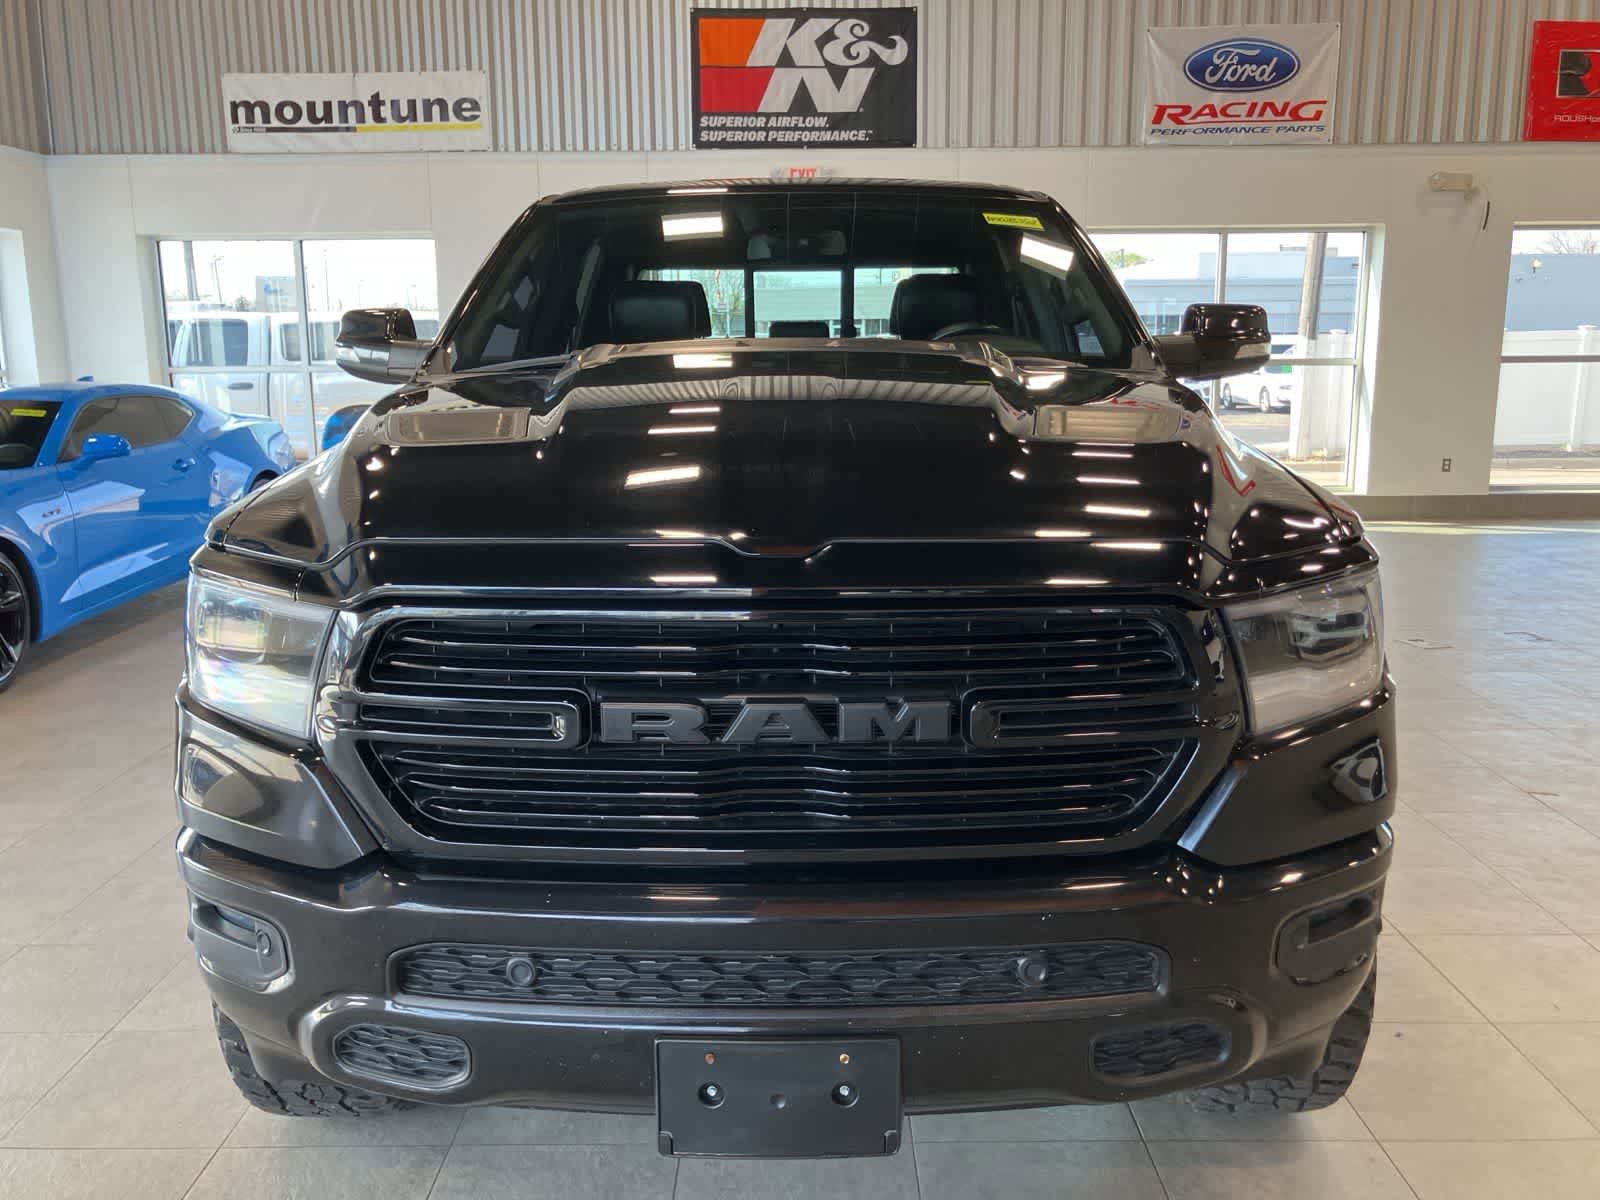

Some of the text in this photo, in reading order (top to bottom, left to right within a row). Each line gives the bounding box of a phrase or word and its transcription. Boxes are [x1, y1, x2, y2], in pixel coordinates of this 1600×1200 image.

[1205, 47, 1279, 83] Ford
[229, 90, 482, 125] mountune
[1151, 99, 1328, 126] RACING
[700, 116, 830, 128] SUPERIOR AIRFLOW.
[1150, 125, 1326, 136] PERFORMANCE PARTS
[700, 130, 766, 142] SUPERIOR
[600, 700, 951, 744] RAM
